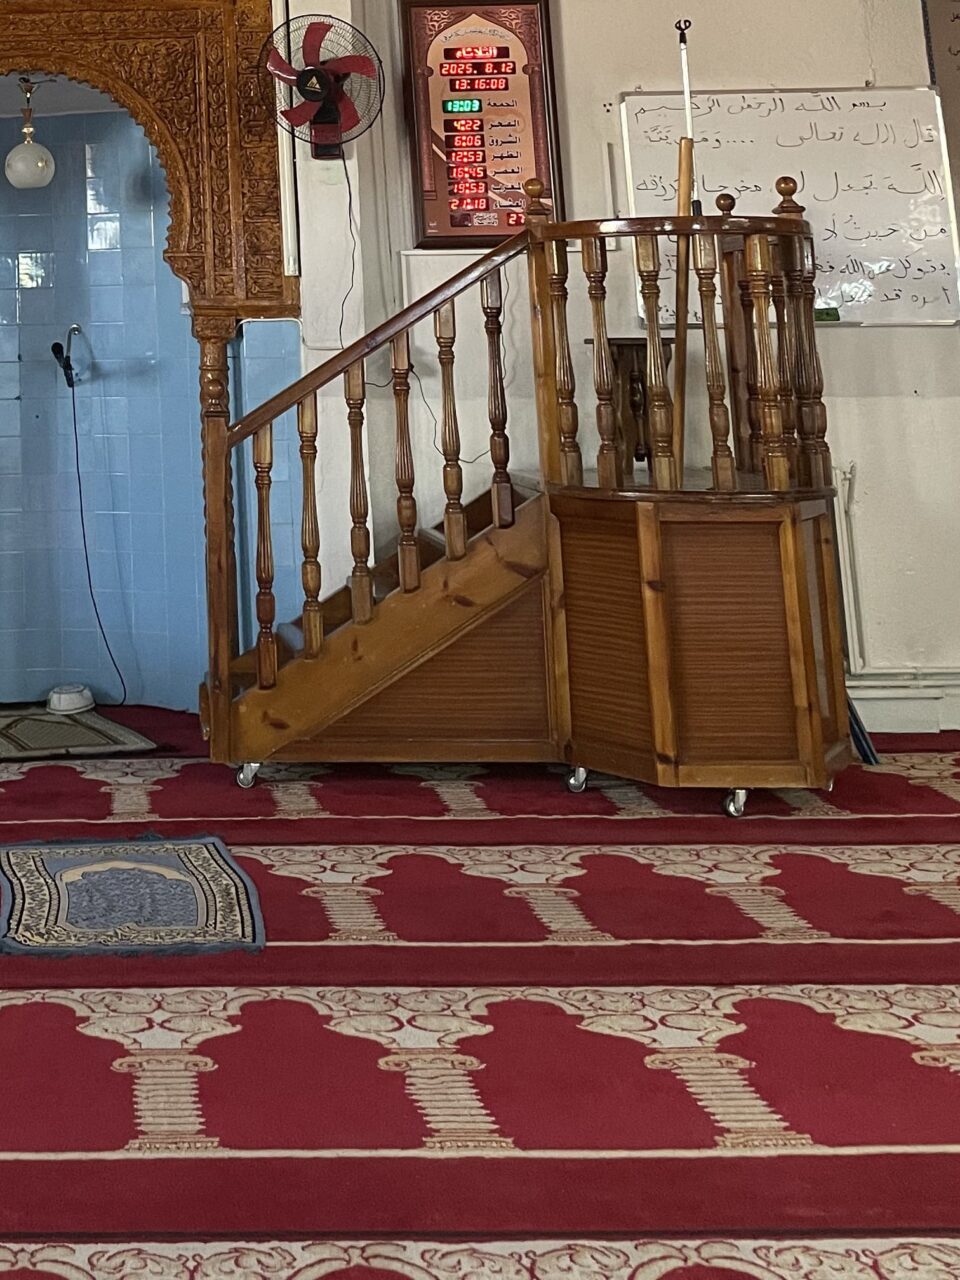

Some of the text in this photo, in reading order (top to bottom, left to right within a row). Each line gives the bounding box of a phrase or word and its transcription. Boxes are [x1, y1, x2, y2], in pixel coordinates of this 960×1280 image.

[454, 78, 507, 90] 13:16:08
[446, 99, 481, 113] 13:03
[486, 99, 519, 109] الجمعة
[453, 119, 482, 132] 4:22
[453, 135, 482, 148] 6:06
[488, 133, 521, 147] الشروق
[451, 151, 484, 163] 12:53
[490, 150, 522, 162] الظهر
[451, 167, 485, 179] 16:45
[491, 166, 523, 177] العصر
